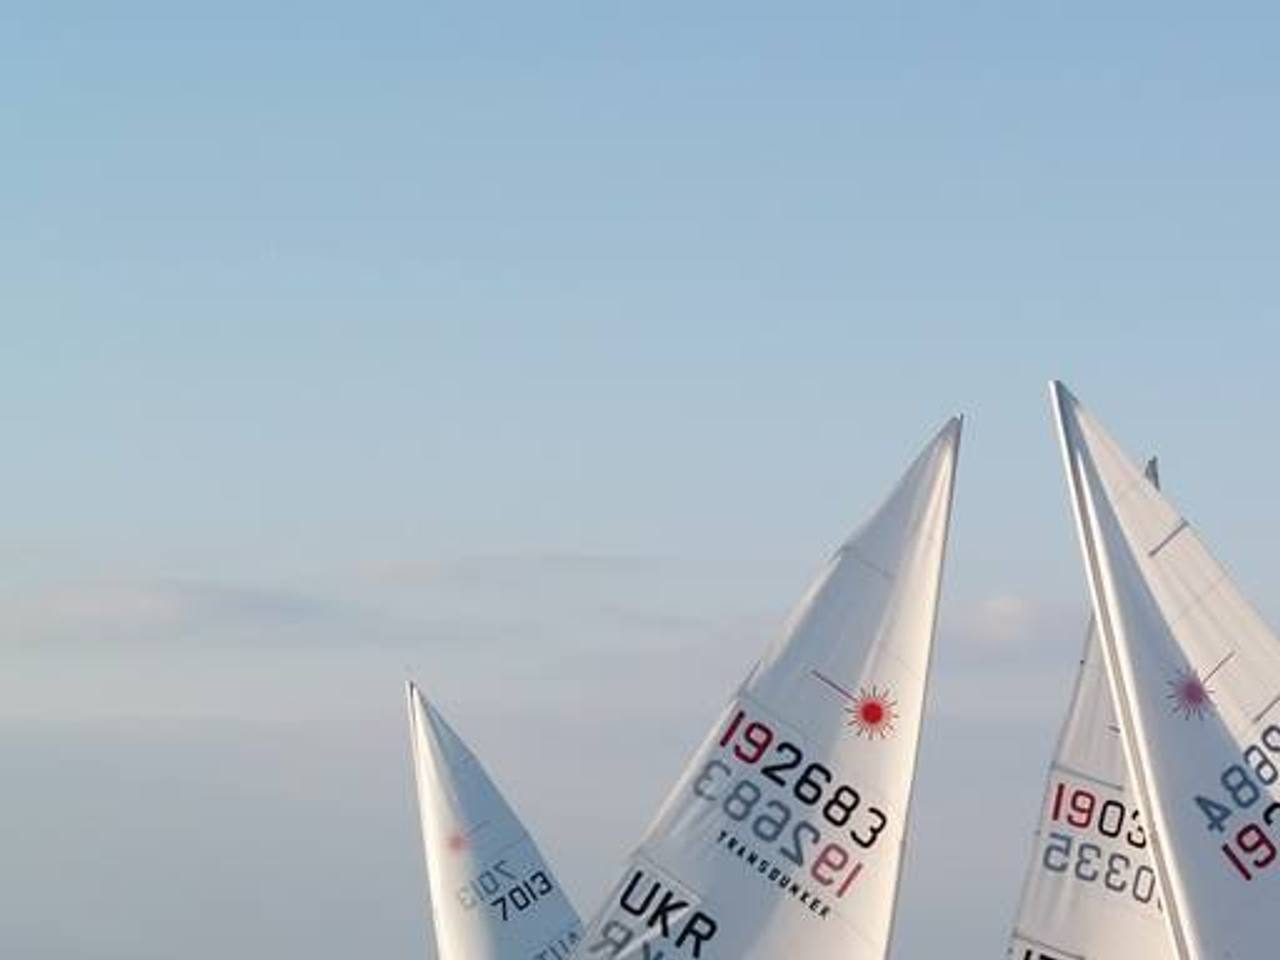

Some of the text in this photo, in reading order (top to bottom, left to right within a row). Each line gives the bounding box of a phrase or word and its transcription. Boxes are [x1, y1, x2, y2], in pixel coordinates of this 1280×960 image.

[720, 710, 887, 848] 192683
[490, 871, 552, 921] 7013
[621, 870, 717, 959] UKR
